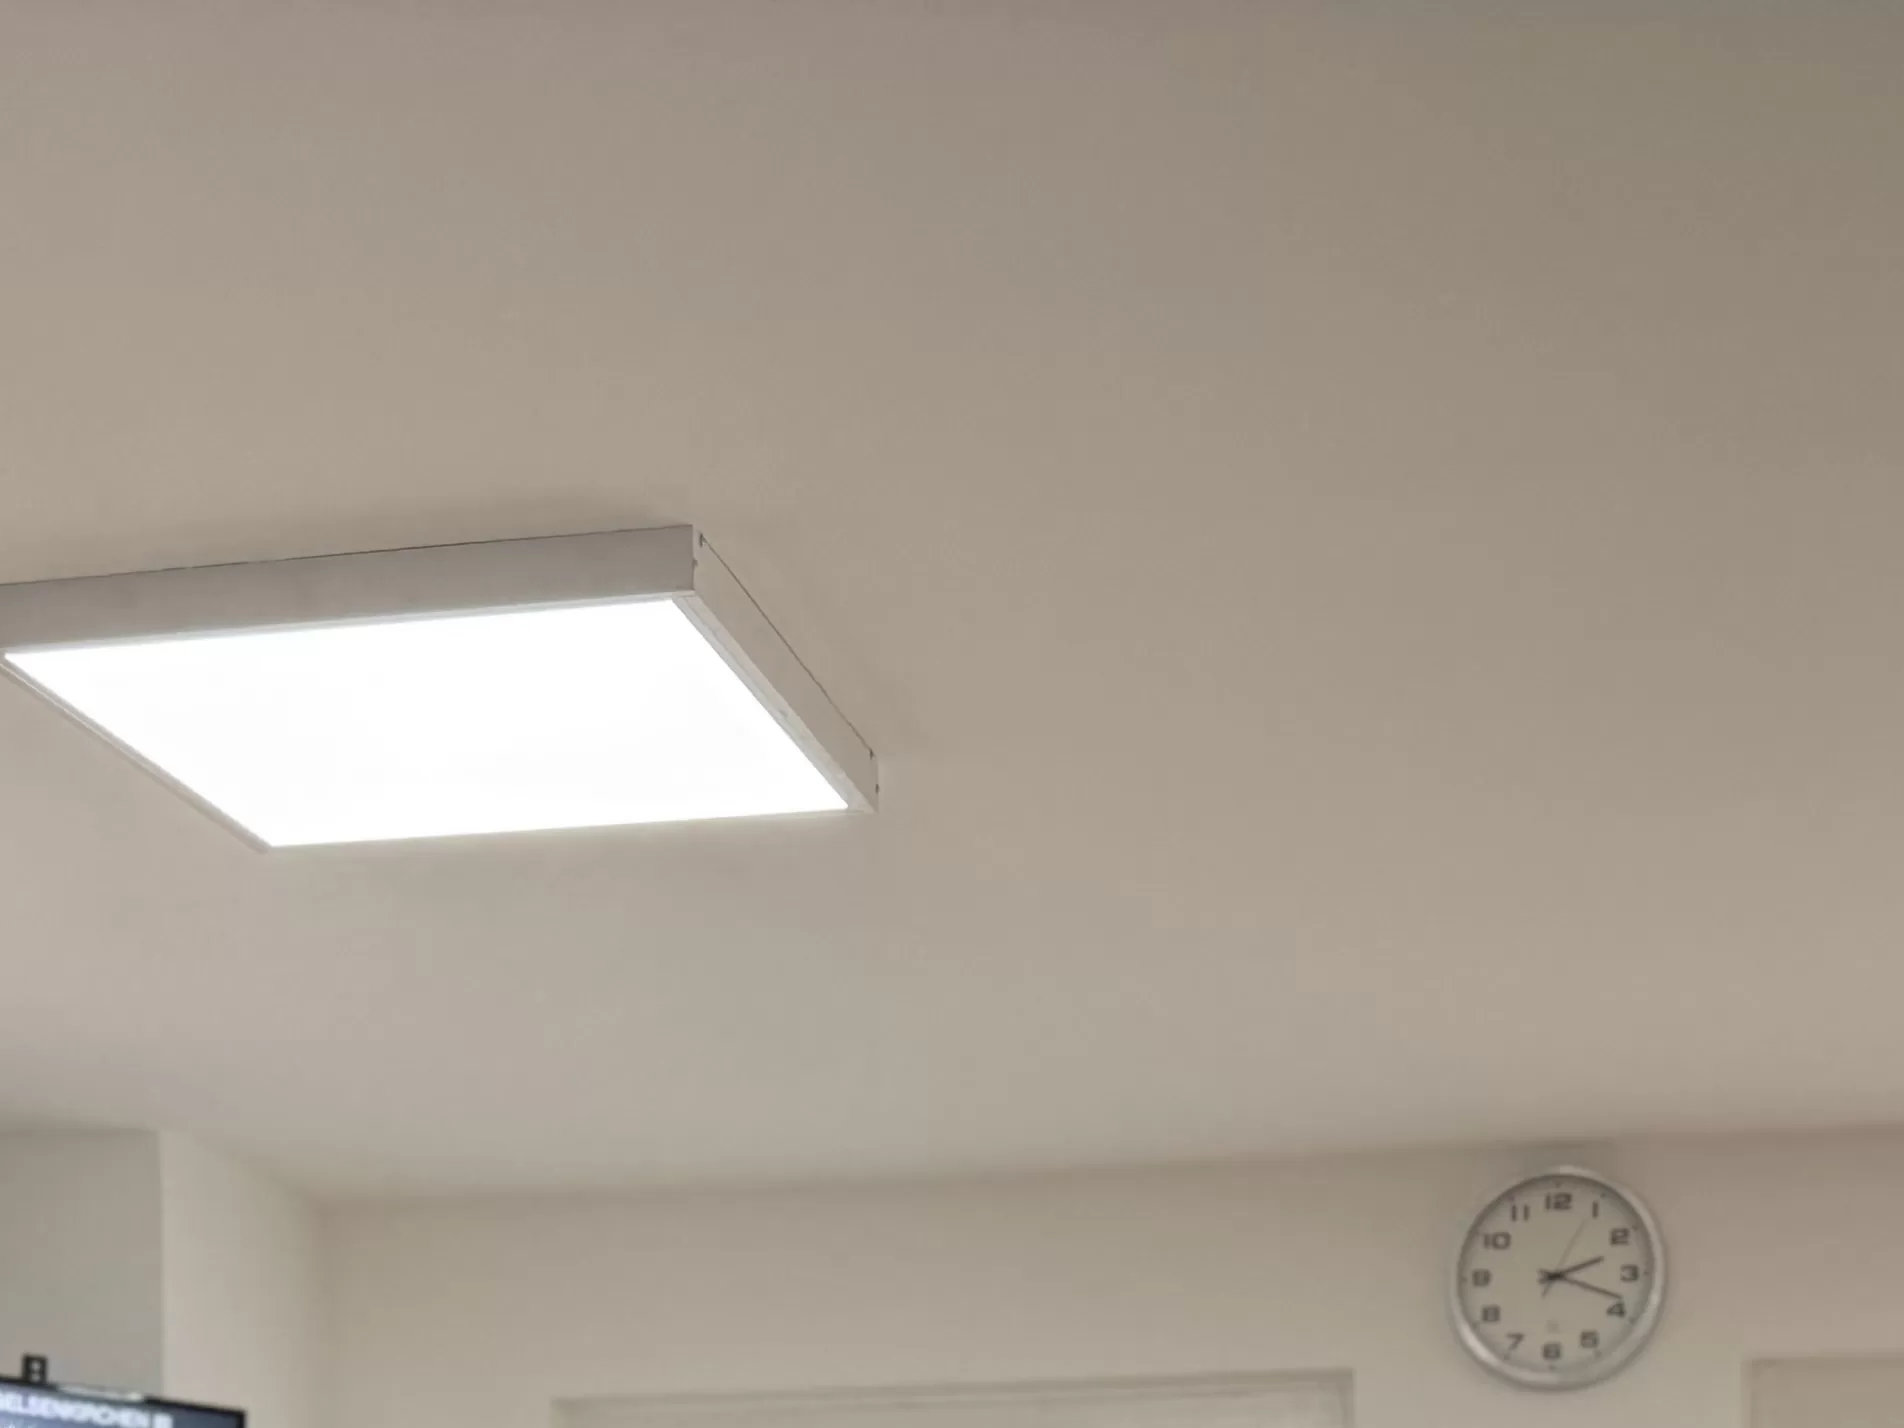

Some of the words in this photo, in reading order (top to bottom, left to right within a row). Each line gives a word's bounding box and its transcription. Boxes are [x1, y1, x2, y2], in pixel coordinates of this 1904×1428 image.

[1545, 1193, 1573, 1211] 12
[1483, 1231, 1512, 1250] 10
[1609, 1228, 1630, 1246] 2
[1620, 1264, 1640, 1283] 3
[1606, 1302, 1626, 1318] 4
[1506, 1332, 1526, 1350] 7
